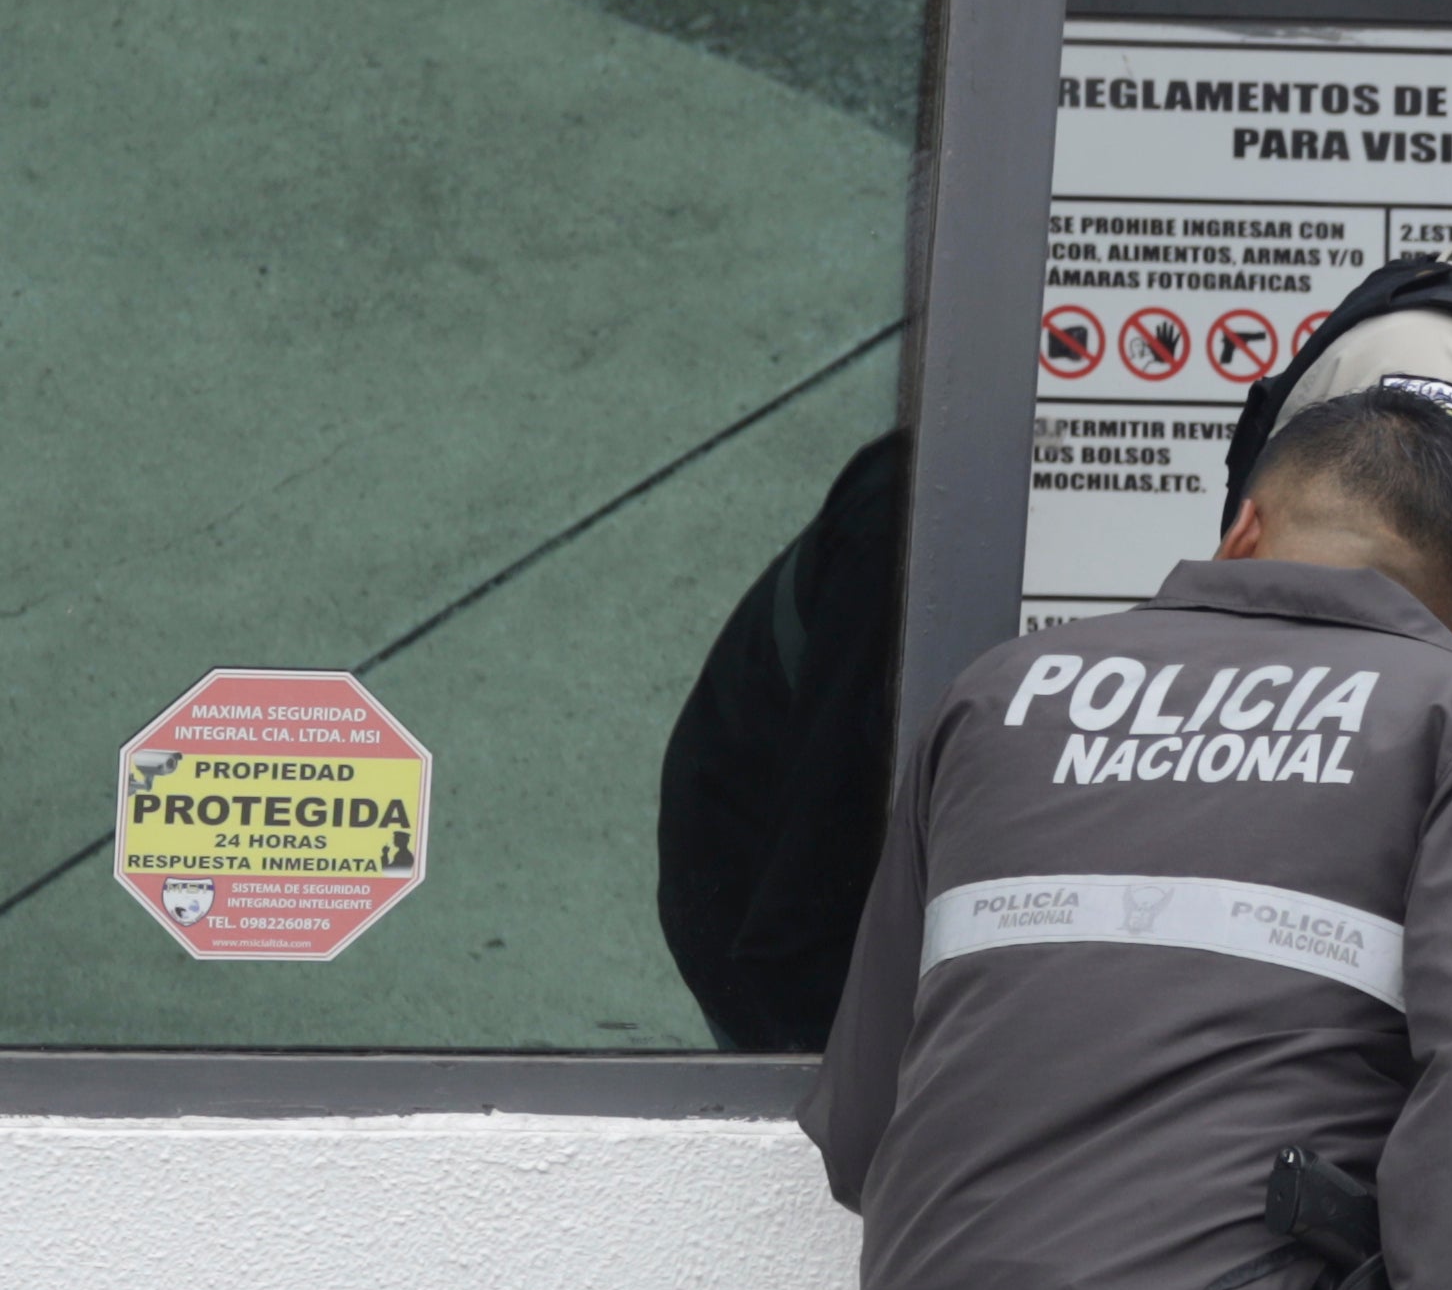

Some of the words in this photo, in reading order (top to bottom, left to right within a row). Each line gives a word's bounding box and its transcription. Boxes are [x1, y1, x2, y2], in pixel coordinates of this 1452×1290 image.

[1057, 78, 1380, 117] REGLAMENTOS
[1393, 86, 1447, 118] DE
[1234, 128, 1350, 161] PARA
[1081, 217, 1178, 237] PROHIBE
[1183, 219, 1293, 239] INGRESAR
[1300, 221, 1345, 240] CON
[1108, 243, 1237, 266] ALIMENTOS,
[1243, 246, 1320, 266] ARMAS
[1328, 248, 1364, 268] Y/O
[1045, 265, 1142, 288] ÁMARAS
[1148, 268, 1312, 292] FOTOGRÁFICAS
[1034, 417, 1165, 439] 3.PERMITIR
[1033, 446, 1074, 464] LOS
[1081, 447, 1171, 465] BOLSOS
[1033, 472, 1207, 493] MOCHILAS,ETC.
[1004, 654, 1380, 736] POLICIA
[191, 704, 263, 720] MAXIMA
[267, 706, 367, 723] SEGURIDAD
[174, 726, 255, 741] INTEGRAL
[261, 727, 295, 742] CIA.
[298, 728, 346, 743] LTDA.
[350, 729, 381, 744] MSI
[1052, 733, 1354, 785] NACIONAL
[194, 761, 355, 782] PROPIEDAD
[132, 794, 411, 829] PROTEGIDA
[214, 833, 241, 849] 24
[249, 835, 328, 850] HORAS
[127, 854, 251, 870] RESPUESTA
[261, 856, 378, 872] INMEDIATA
[231, 882, 281, 894] SISTEMA
[284, 883, 300, 894] DE
[302, 883, 371, 895] SEGURIDAD
[227, 897, 296, 909] INTEGRADO
[299, 898, 373, 910] INTELIGENTE
[206, 915, 237, 929] TEL.
[240, 917, 330, 931] 0982260876
[997, 908, 1074, 930] NACIONAL
[1268, 927, 1360, 969] NACIONAL
